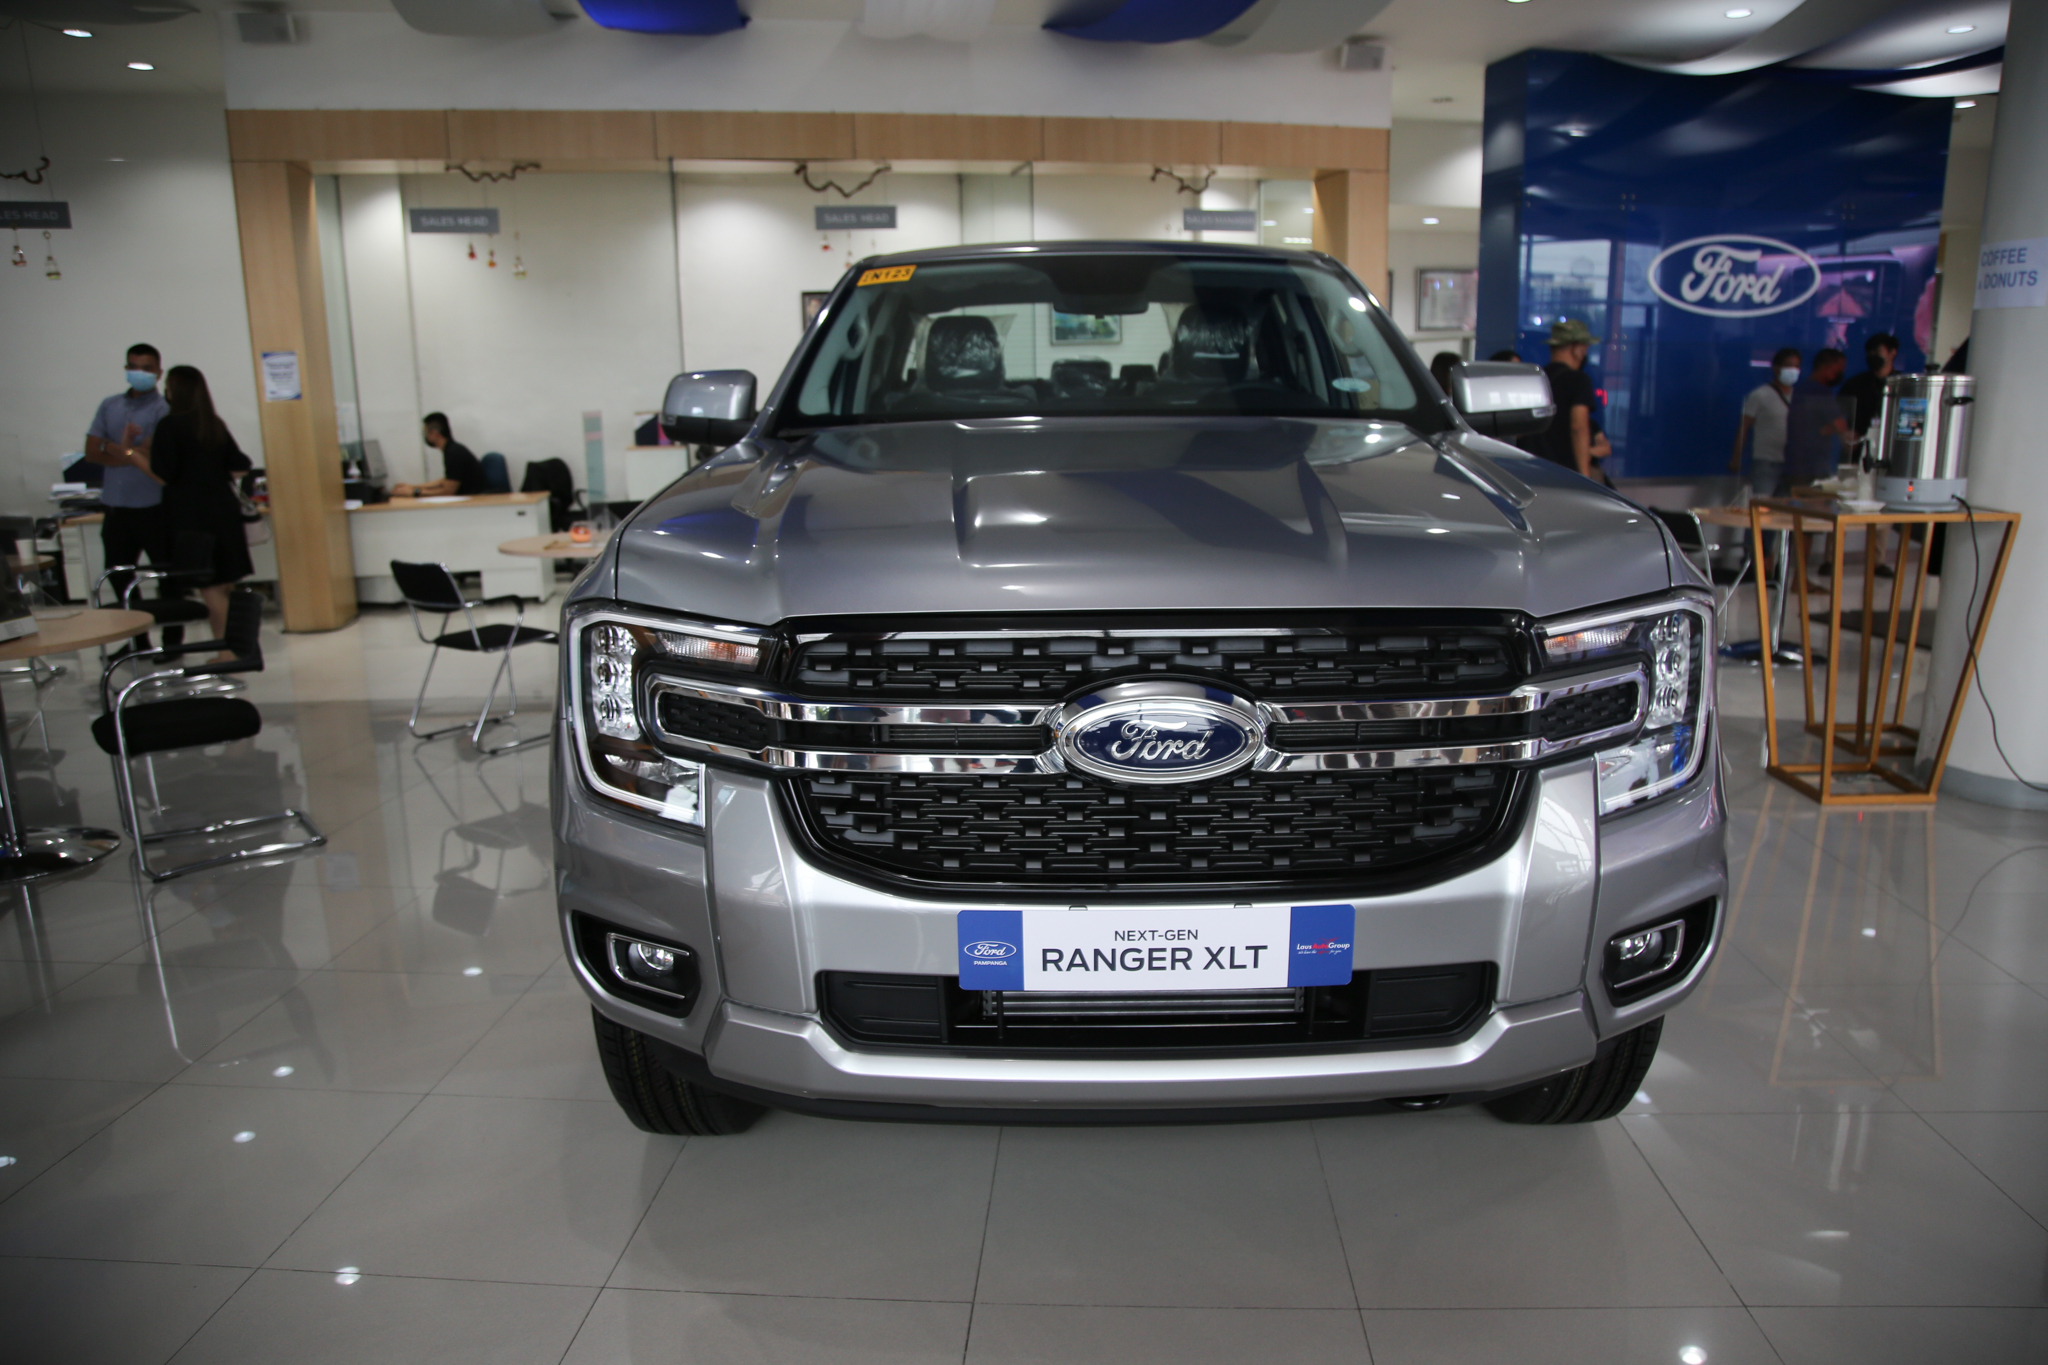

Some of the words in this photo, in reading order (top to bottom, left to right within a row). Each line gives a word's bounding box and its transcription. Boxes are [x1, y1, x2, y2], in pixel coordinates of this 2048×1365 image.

[23, 210, 59, 220] HEAD
[420, 215, 456, 227] SALES
[457, 215, 489, 227] HEAD
[823, 212, 858, 224] SALES
[860, 212, 890, 224] HEAD
[1981, 247, 2027, 267] COFFEE
[1681, 245, 1786, 304] Ford
[1983, 270, 2038, 290] DONUTS
[1111, 719, 1214, 761] Ford
[1114, 929, 1199, 942] NEXT-GEN
[974, 943, 1006, 956] Ford
[1041, 947, 1193, 972] RANGER
[1202, 945, 1268, 971] XLT
